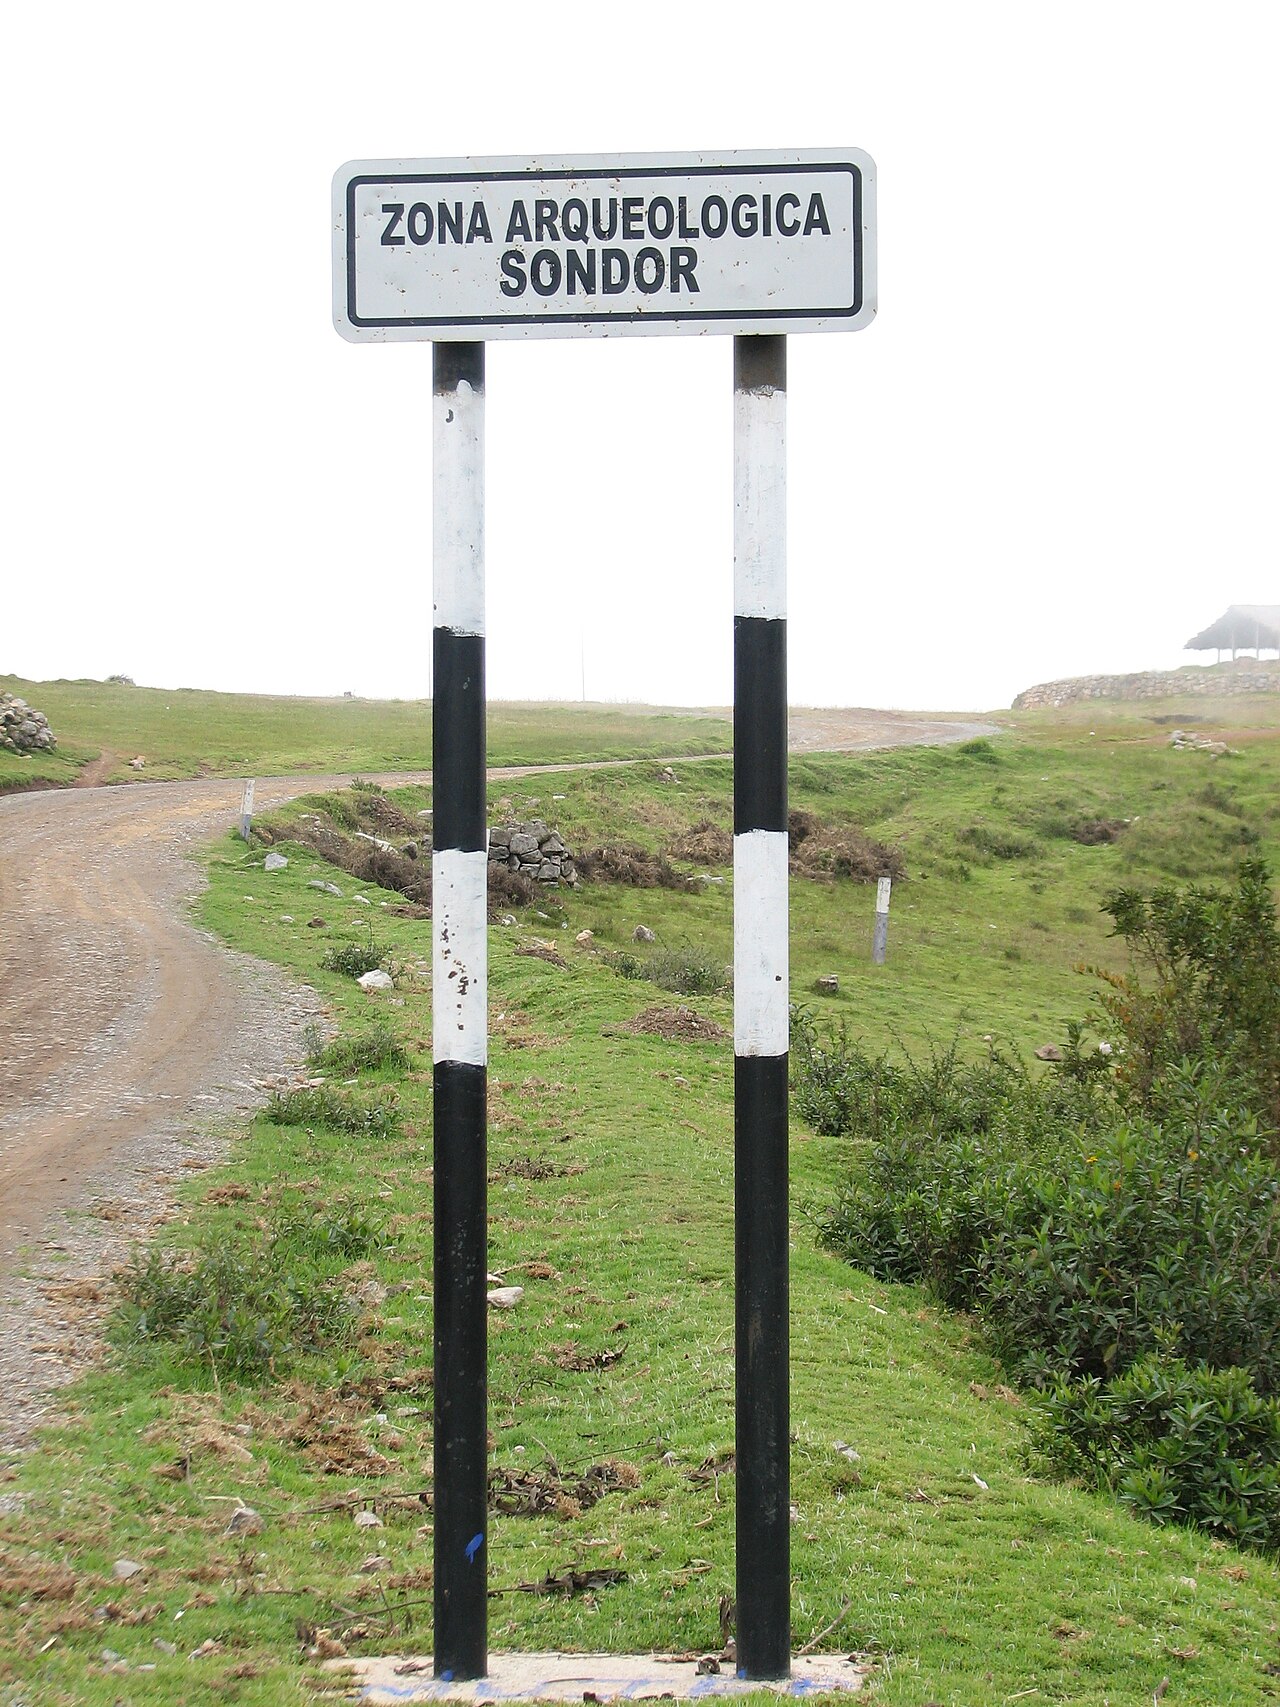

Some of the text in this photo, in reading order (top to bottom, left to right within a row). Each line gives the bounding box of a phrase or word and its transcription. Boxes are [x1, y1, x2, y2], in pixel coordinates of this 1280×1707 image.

[380, 192, 831, 246] ZONA ARQUEOLOGICA
[499, 246, 701, 298] SONDOR
